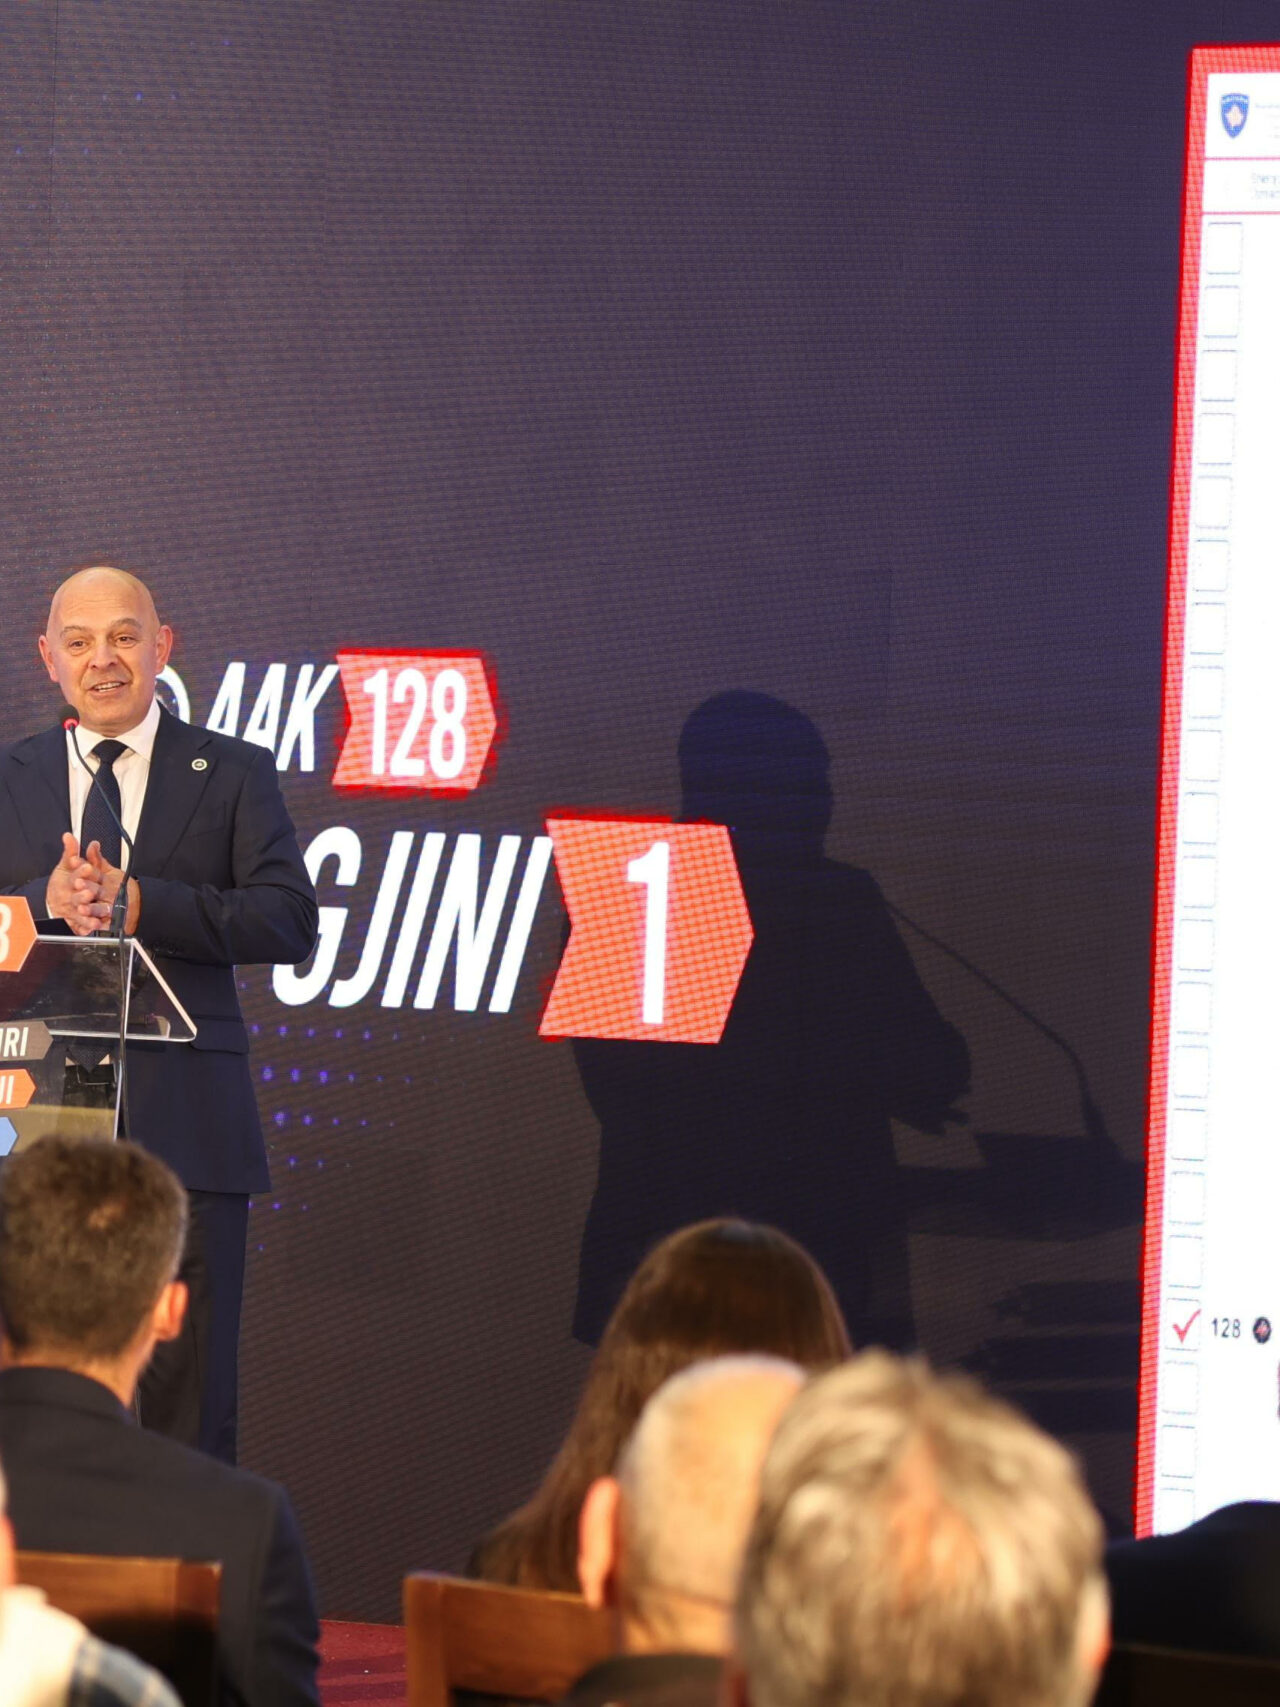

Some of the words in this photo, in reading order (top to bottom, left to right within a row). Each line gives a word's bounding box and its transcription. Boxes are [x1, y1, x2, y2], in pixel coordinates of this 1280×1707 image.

[206, 662, 340, 772] AAK
[363, 668, 467, 779] 128
[273, 826, 553, 1013] GJINI
[628, 842, 670, 1024] 1
[1211, 1317, 1241, 1339] 128
